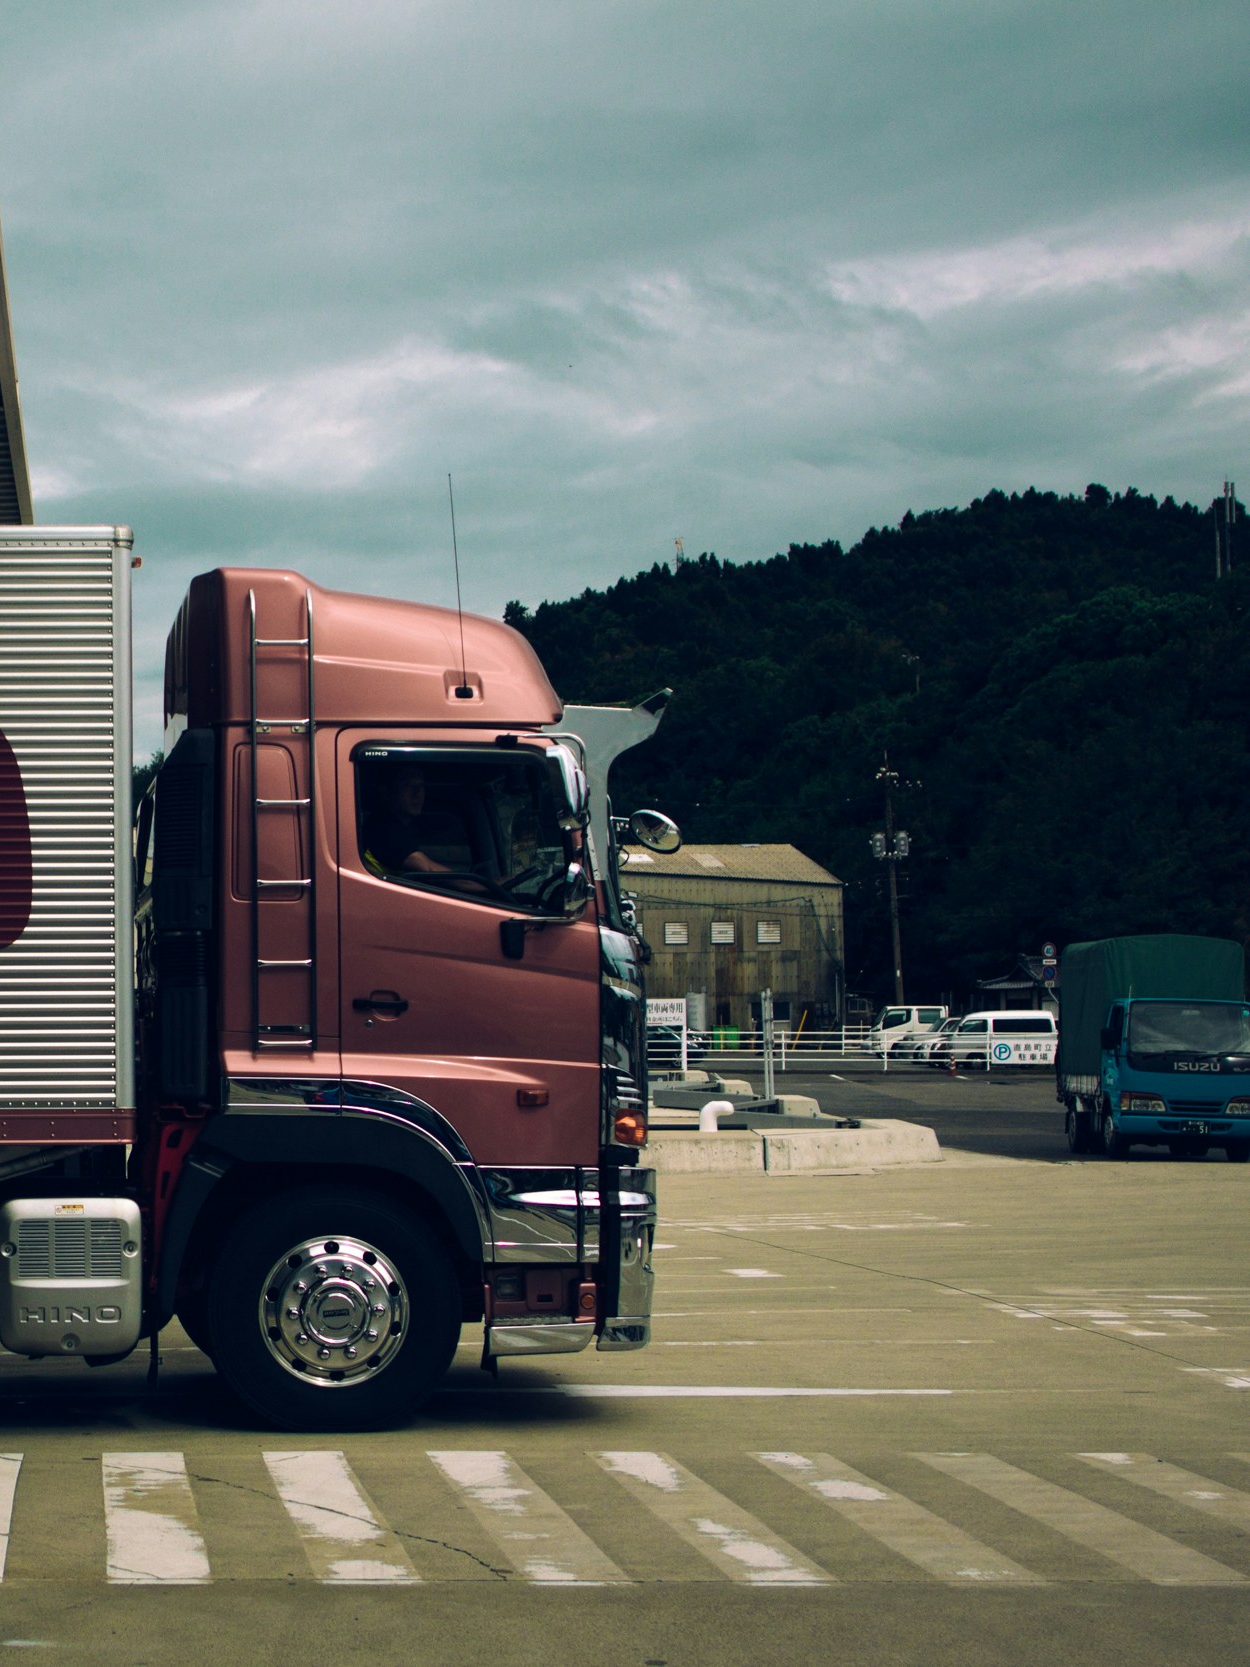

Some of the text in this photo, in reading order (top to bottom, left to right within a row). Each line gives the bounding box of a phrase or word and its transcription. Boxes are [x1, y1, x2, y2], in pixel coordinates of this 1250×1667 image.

[998, 1046, 1008, 1057] P
[1018, 1053, 1048, 1061] 駐車場
[1174, 1062, 1220, 1072] ISUZU
[20, 1305, 122, 1324] HINO
